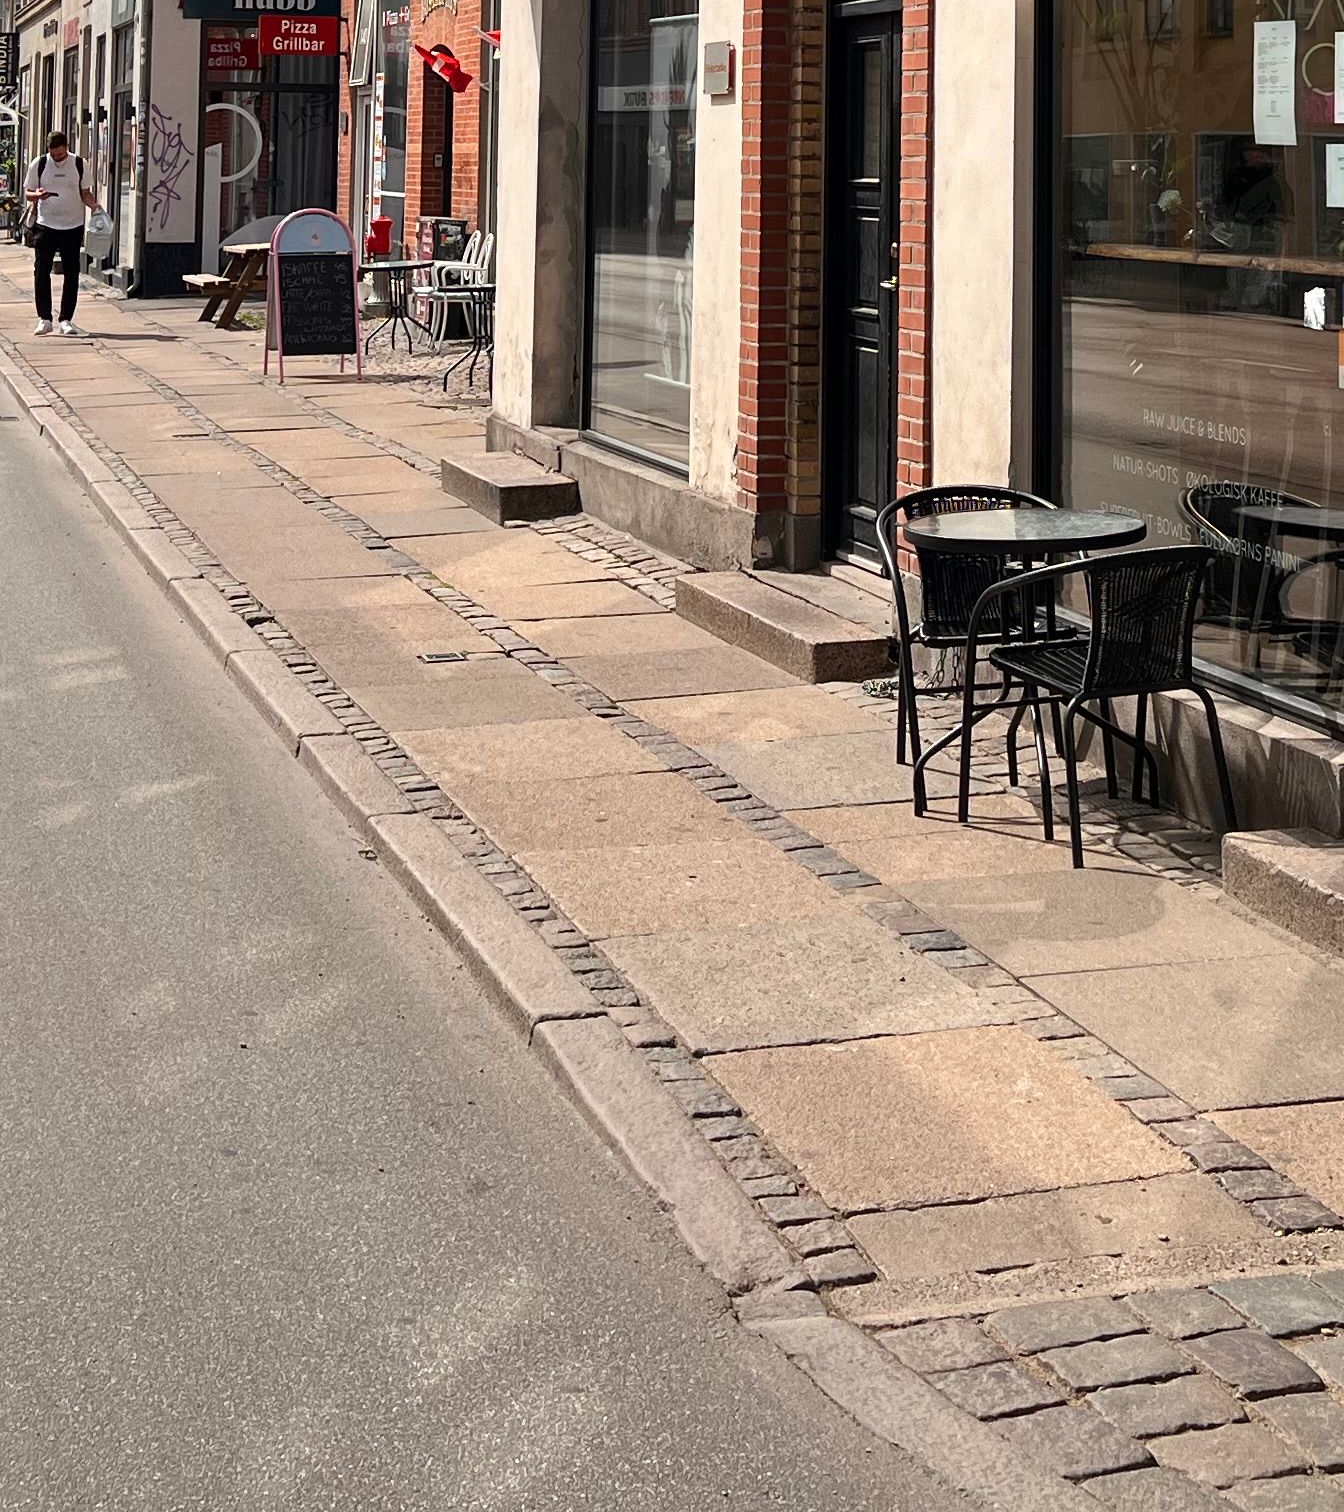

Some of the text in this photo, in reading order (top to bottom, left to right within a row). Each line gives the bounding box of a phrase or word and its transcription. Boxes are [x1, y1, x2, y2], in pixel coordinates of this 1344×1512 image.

[281, 20, 317, 34] Pizza
[272, 36, 325, 51] Grillbar
[1143, 408, 1247, 446] RAW JUICE & BLENDS
[1186, 471, 1248, 503] ØKOLOGISK
[1249, 487, 1284, 511] KAFFE
[1264, 545, 1301, 574] PANINI
